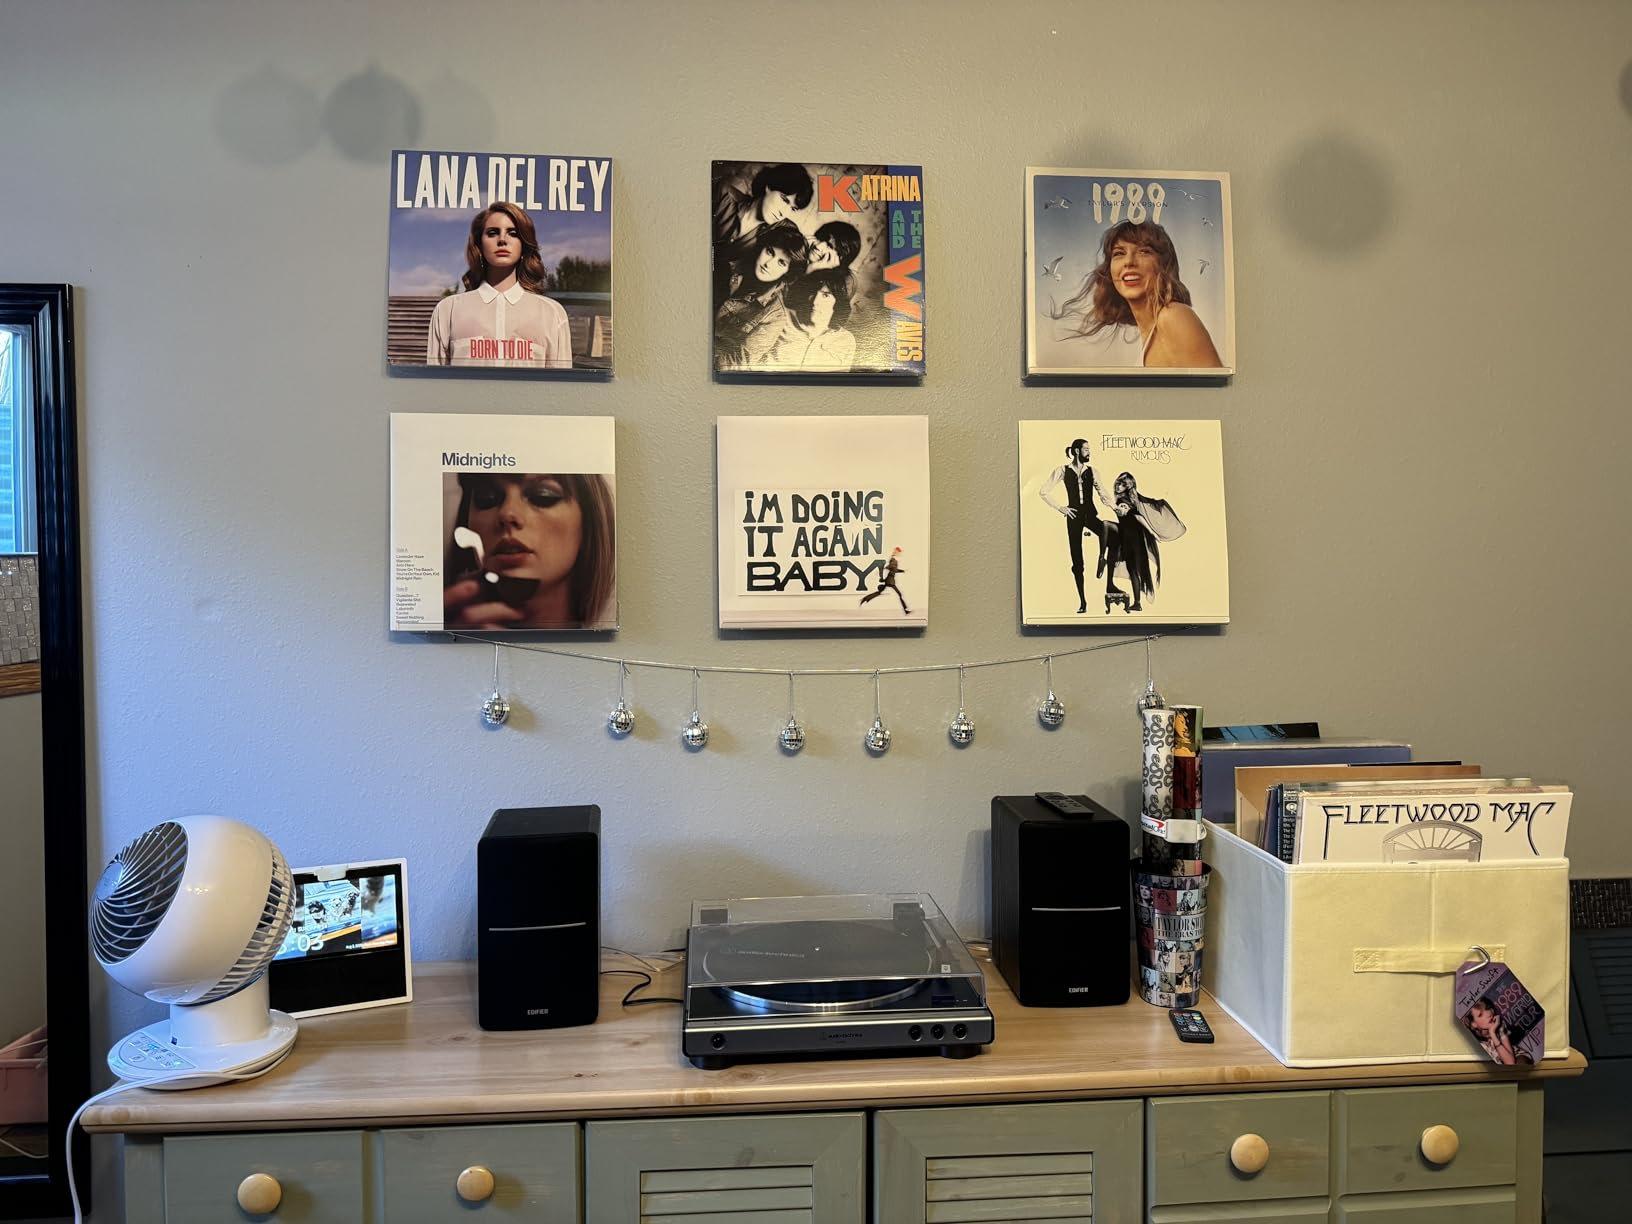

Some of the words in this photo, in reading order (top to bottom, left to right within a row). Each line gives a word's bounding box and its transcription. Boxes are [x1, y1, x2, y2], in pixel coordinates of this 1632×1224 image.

[396, 153, 481, 209] LANA
[488, 156, 543, 211] DEL
[548, 158, 609, 212] REY
[818, 174, 921, 213] KATRINA
[1092, 182, 1166, 226] 1989
[892, 209, 906, 249] AND
[911, 209, 923, 249] THE
[883, 253, 924, 362] WAVES
[470, 339, 499, 360] BORN
[501, 339, 515, 360] TO
[517, 340, 533, 361] DIE
[1102, 434, 1161, 451] FLEETWOOD
[1161, 434, 1192, 450] MAC
[1131, 450, 1171, 464] RUMOURS
[441, 452, 516, 469] Midnights
[743, 526, 784, 557] IT
[791, 524, 883, 557] AGAIN
[747, 560, 886, 592] BABY
[1322, 803, 1482, 860] FLEETWOOD
[1489, 802, 1556, 856] MAC
[1156, 917, 1190, 931] TAYLOR
[1157, 930, 1173, 939] THE
[1175, 930, 1193, 938] ERAS
[1458, 988, 1480, 1008] Taylor
[1480, 967, 1499, 990] Swift
[1494, 982, 1522, 1010] 1989
[1503, 993, 1532, 1026] WORLD
[1514, 1007, 1540, 1031] TOUR
[1522, 1027, 1540, 1054] VIP
